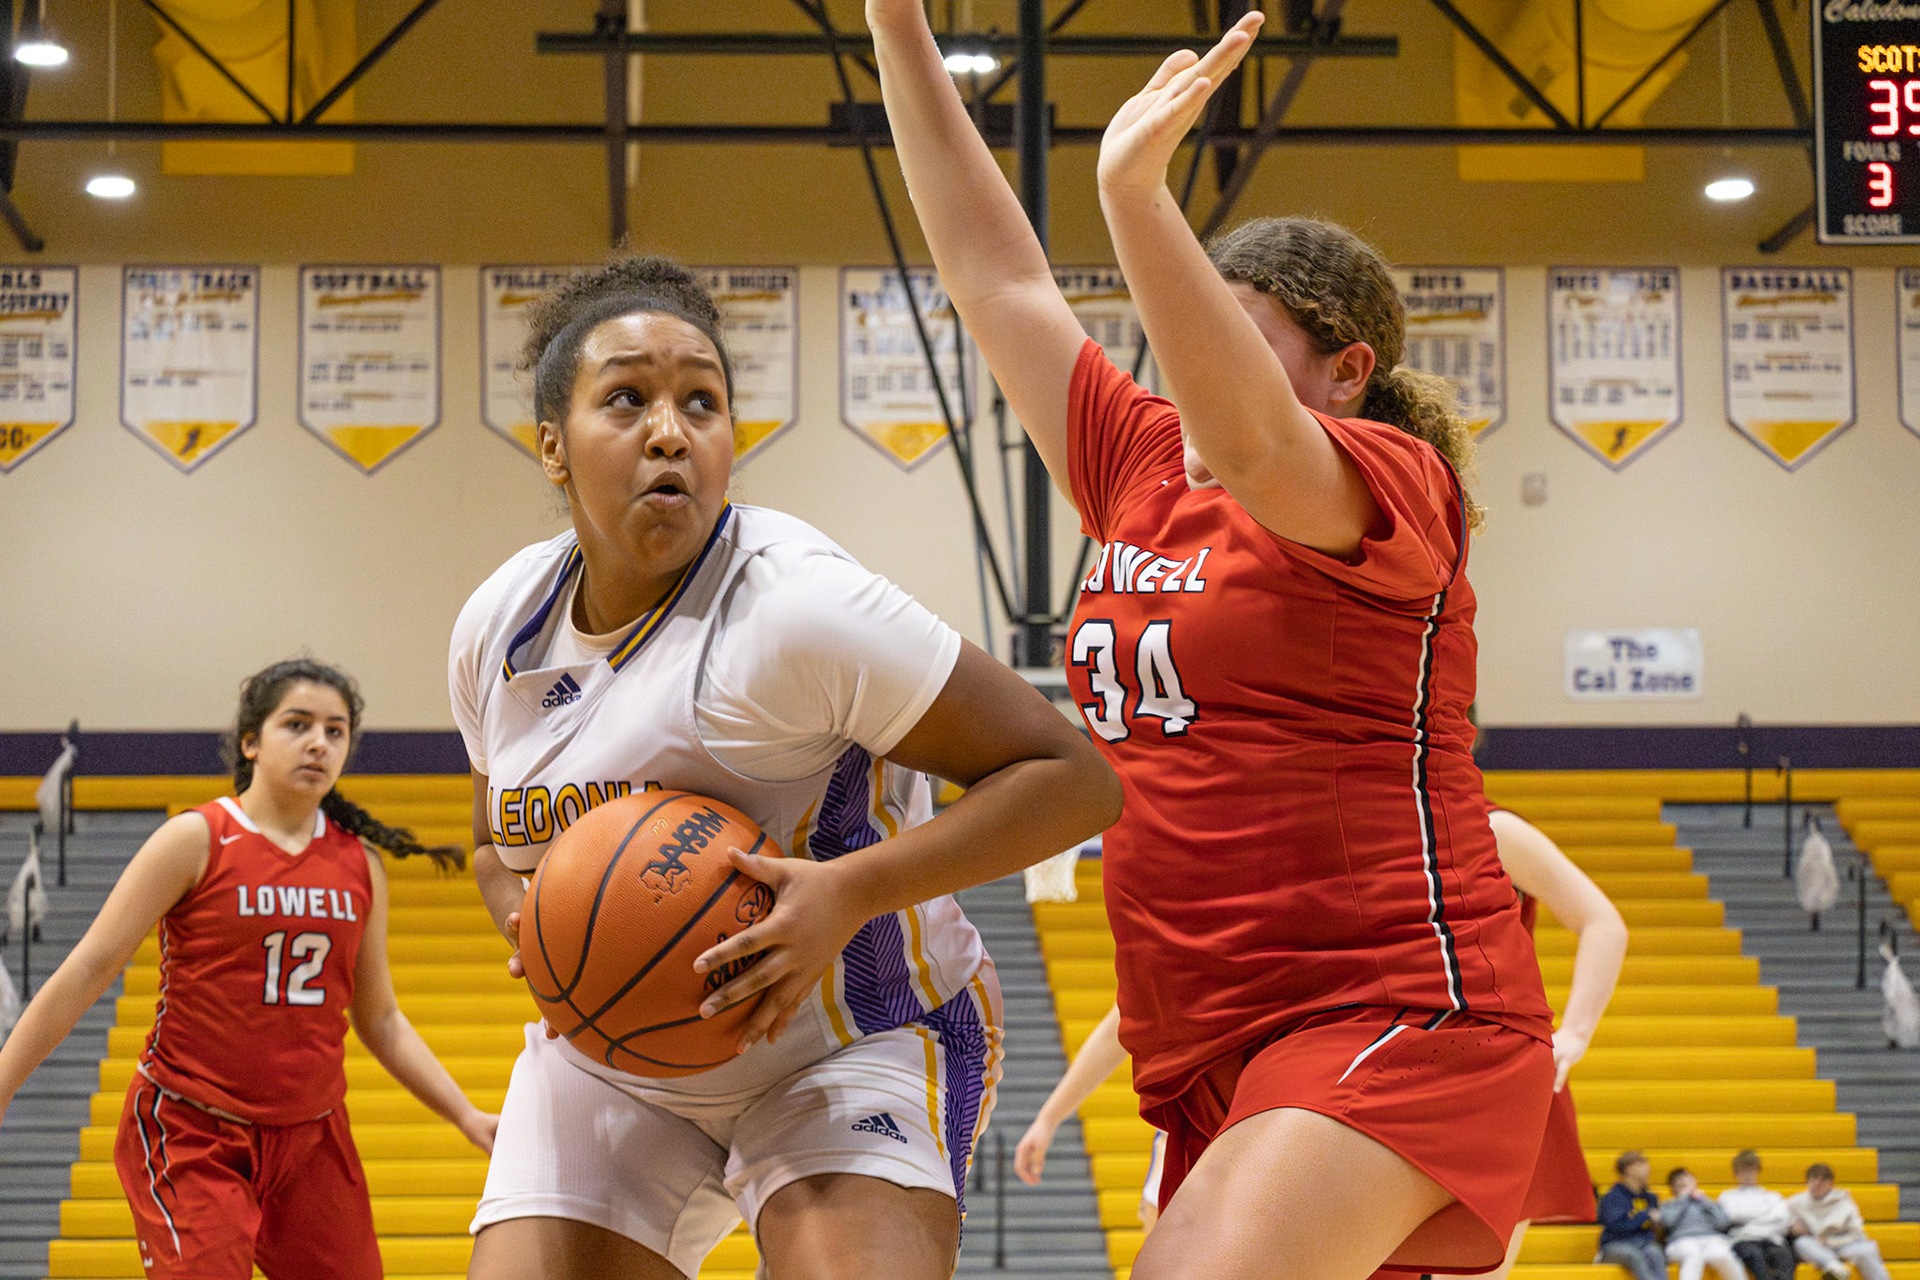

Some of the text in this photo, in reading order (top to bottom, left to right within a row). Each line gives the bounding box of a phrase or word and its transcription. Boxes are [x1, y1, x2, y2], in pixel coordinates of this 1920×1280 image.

[1858, 45, 1920, 73] SCOT
[1868, 162, 1893, 207] 3
[1730, 275, 1845, 291] BASEBALL
[1080, 540, 1212, 593] OWELL
[1609, 638, 1657, 661] The
[1071, 618, 1200, 745] 34
[1574, 667, 1693, 692] Cal Zone
[541, 692, 582, 708] adida
[236, 885, 357, 923] LOWELL
[261, 930, 332, 1007] 12
[851, 1123, 909, 1144] adidas
